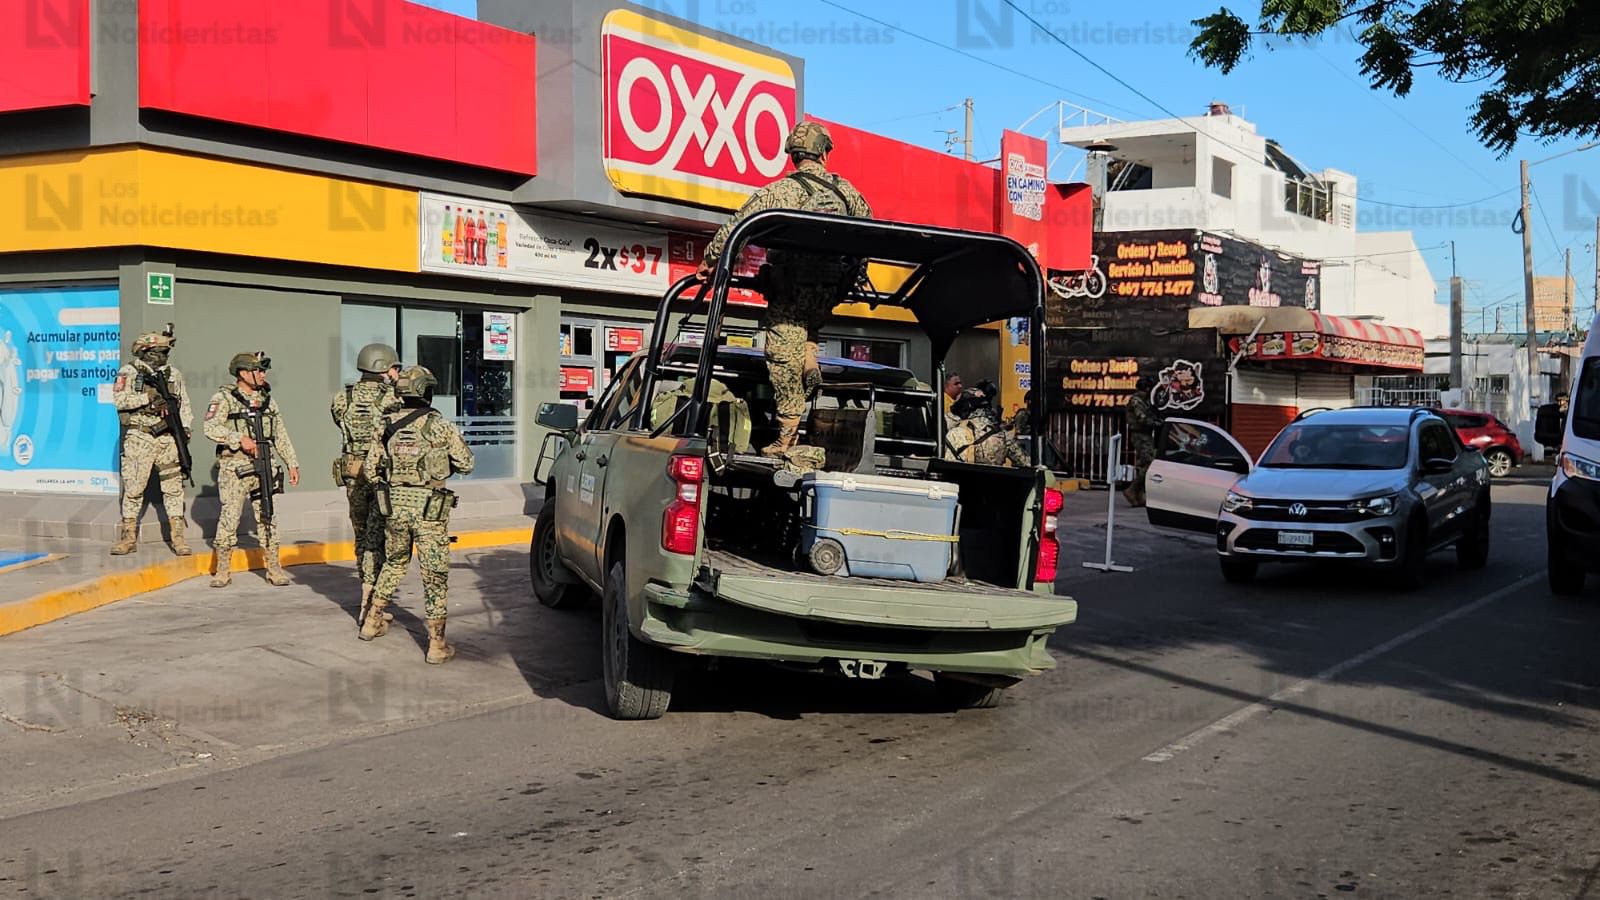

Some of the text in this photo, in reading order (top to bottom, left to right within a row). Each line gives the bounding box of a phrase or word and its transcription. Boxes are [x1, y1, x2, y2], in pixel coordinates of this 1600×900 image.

[617, 57, 790, 178] OXXO
[1007, 177, 1045, 191] EN CAMINO
[1008, 190, 1022, 202] CON
[1149, 245, 1157, 260] y
[1108, 259, 1195, 278] Servicio a Domicilio
[1118, 280, 1195, 297] 667 774 1477
[27, 330, 80, 343] Acumular
[47, 351, 54, 365] y
[56, 348, 97, 361] usarlos
[27, 365, 119, 382] pagar tus antojo
[1102, 361, 1109, 375] y
[1063, 377, 1096, 390] Servicio
[1097, 379, 1104, 390] a
[82, 387, 96, 397] en
[1071, 393, 1092, 407] 667
[1093, 394, 1114, 407] 774
